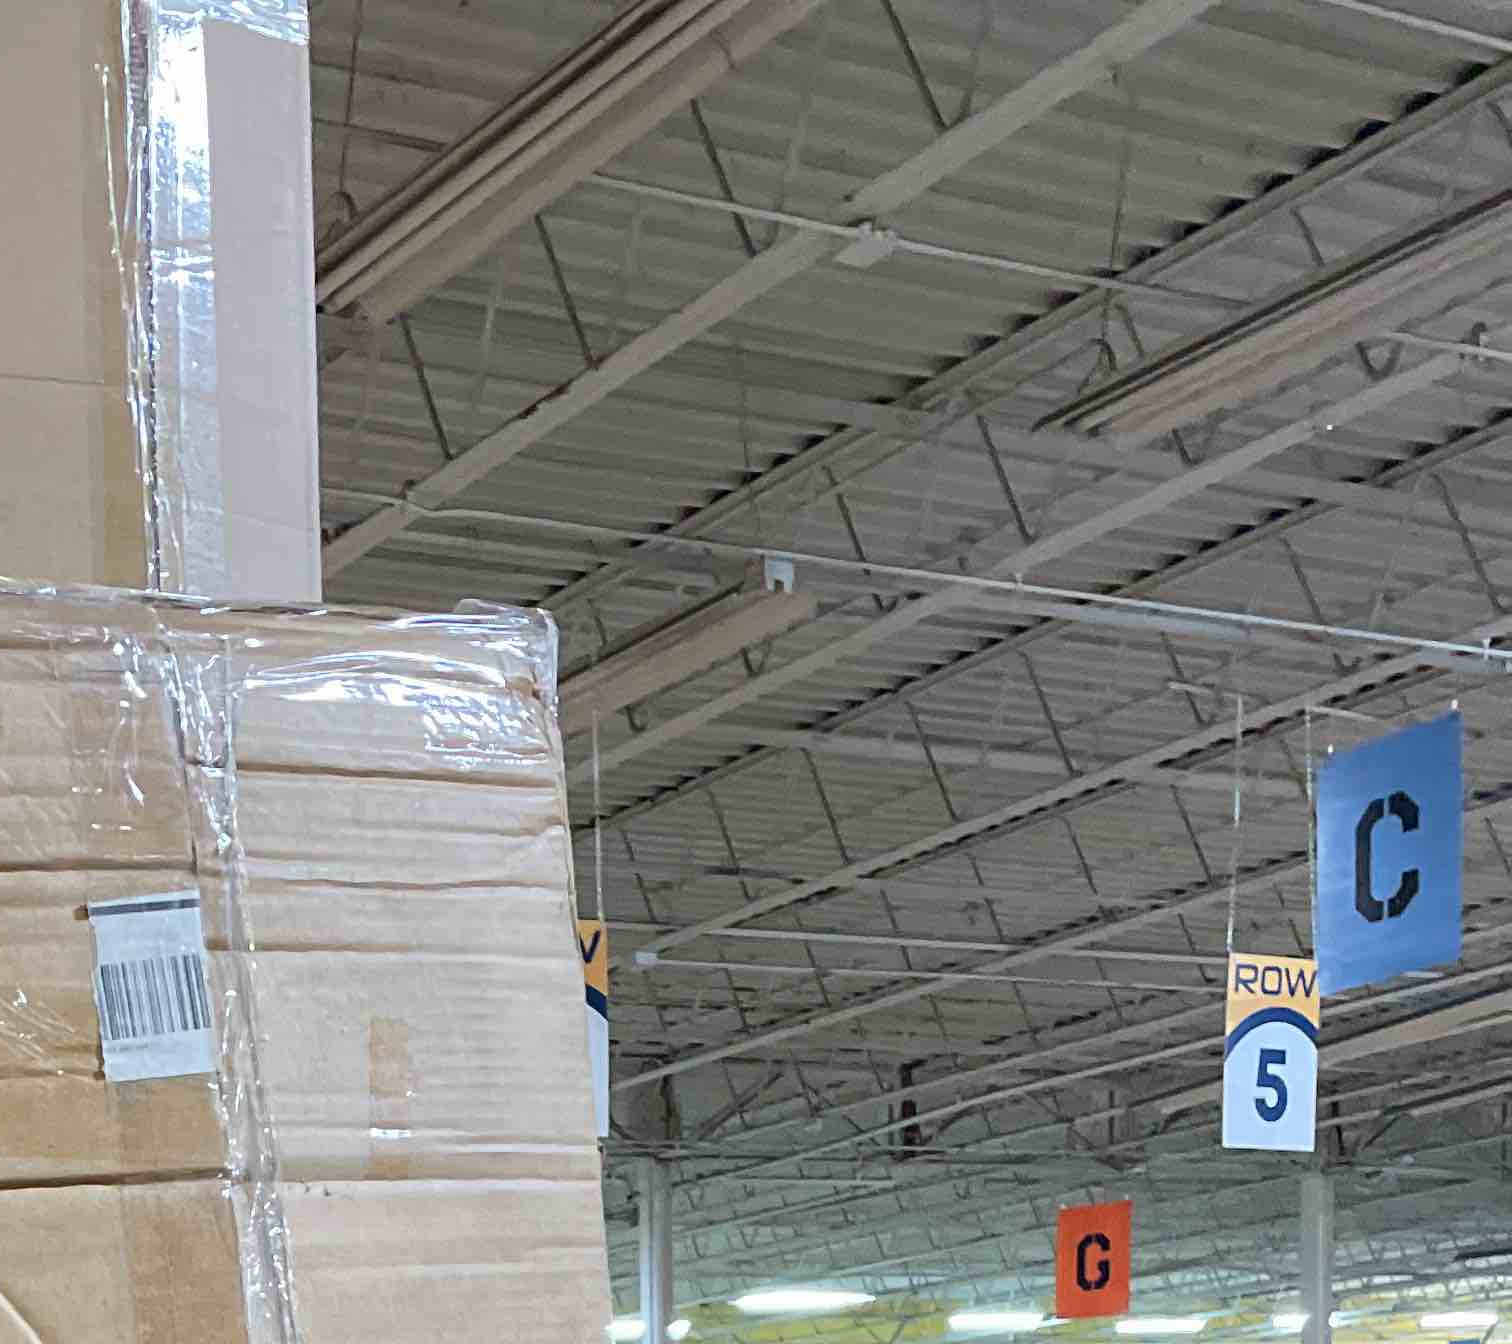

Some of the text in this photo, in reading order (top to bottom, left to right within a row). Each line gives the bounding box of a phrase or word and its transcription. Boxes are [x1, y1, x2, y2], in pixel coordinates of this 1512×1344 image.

[1354, 789, 1420, 924] C
[1234, 963, 1318, 1000] ROW
[1254, 1048, 1289, 1123] 5
[1075, 1231, 1111, 1293] G
